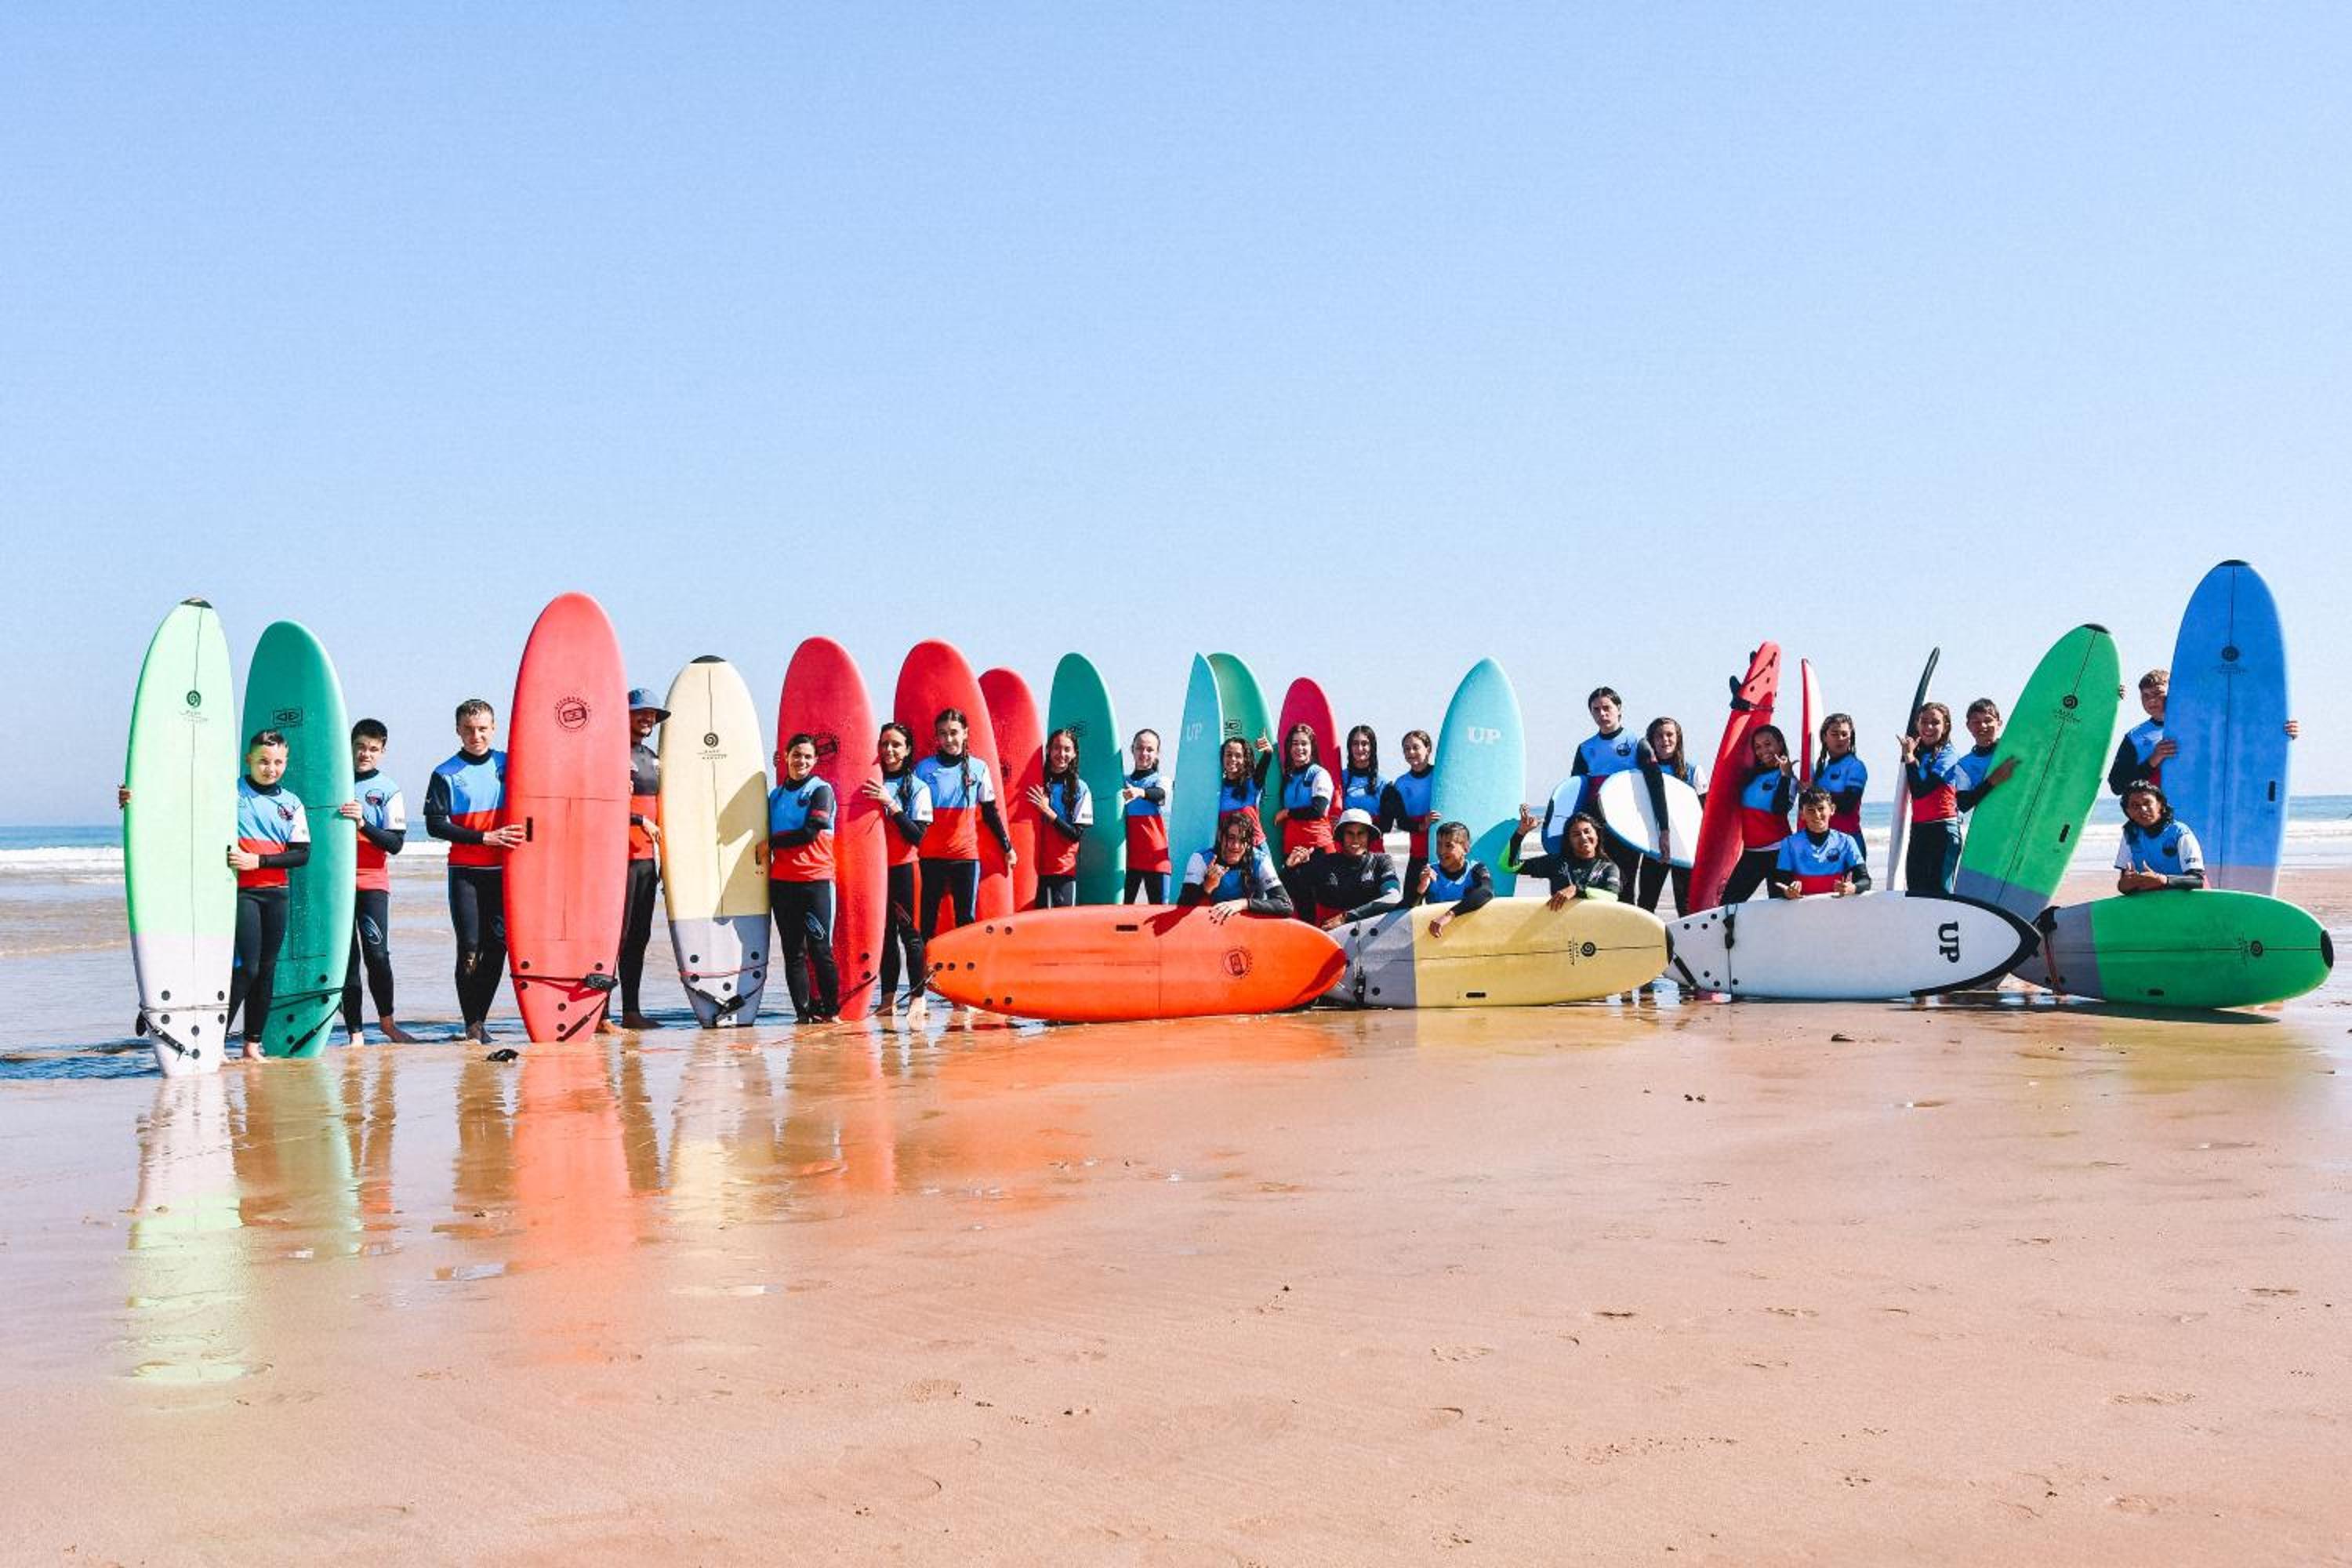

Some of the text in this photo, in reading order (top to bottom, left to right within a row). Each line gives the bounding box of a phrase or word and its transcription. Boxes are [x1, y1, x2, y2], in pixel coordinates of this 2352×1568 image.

[1186, 722, 1203, 741] UP
[1468, 727, 1501, 745] UP
[1938, 921, 1960, 964] UP
